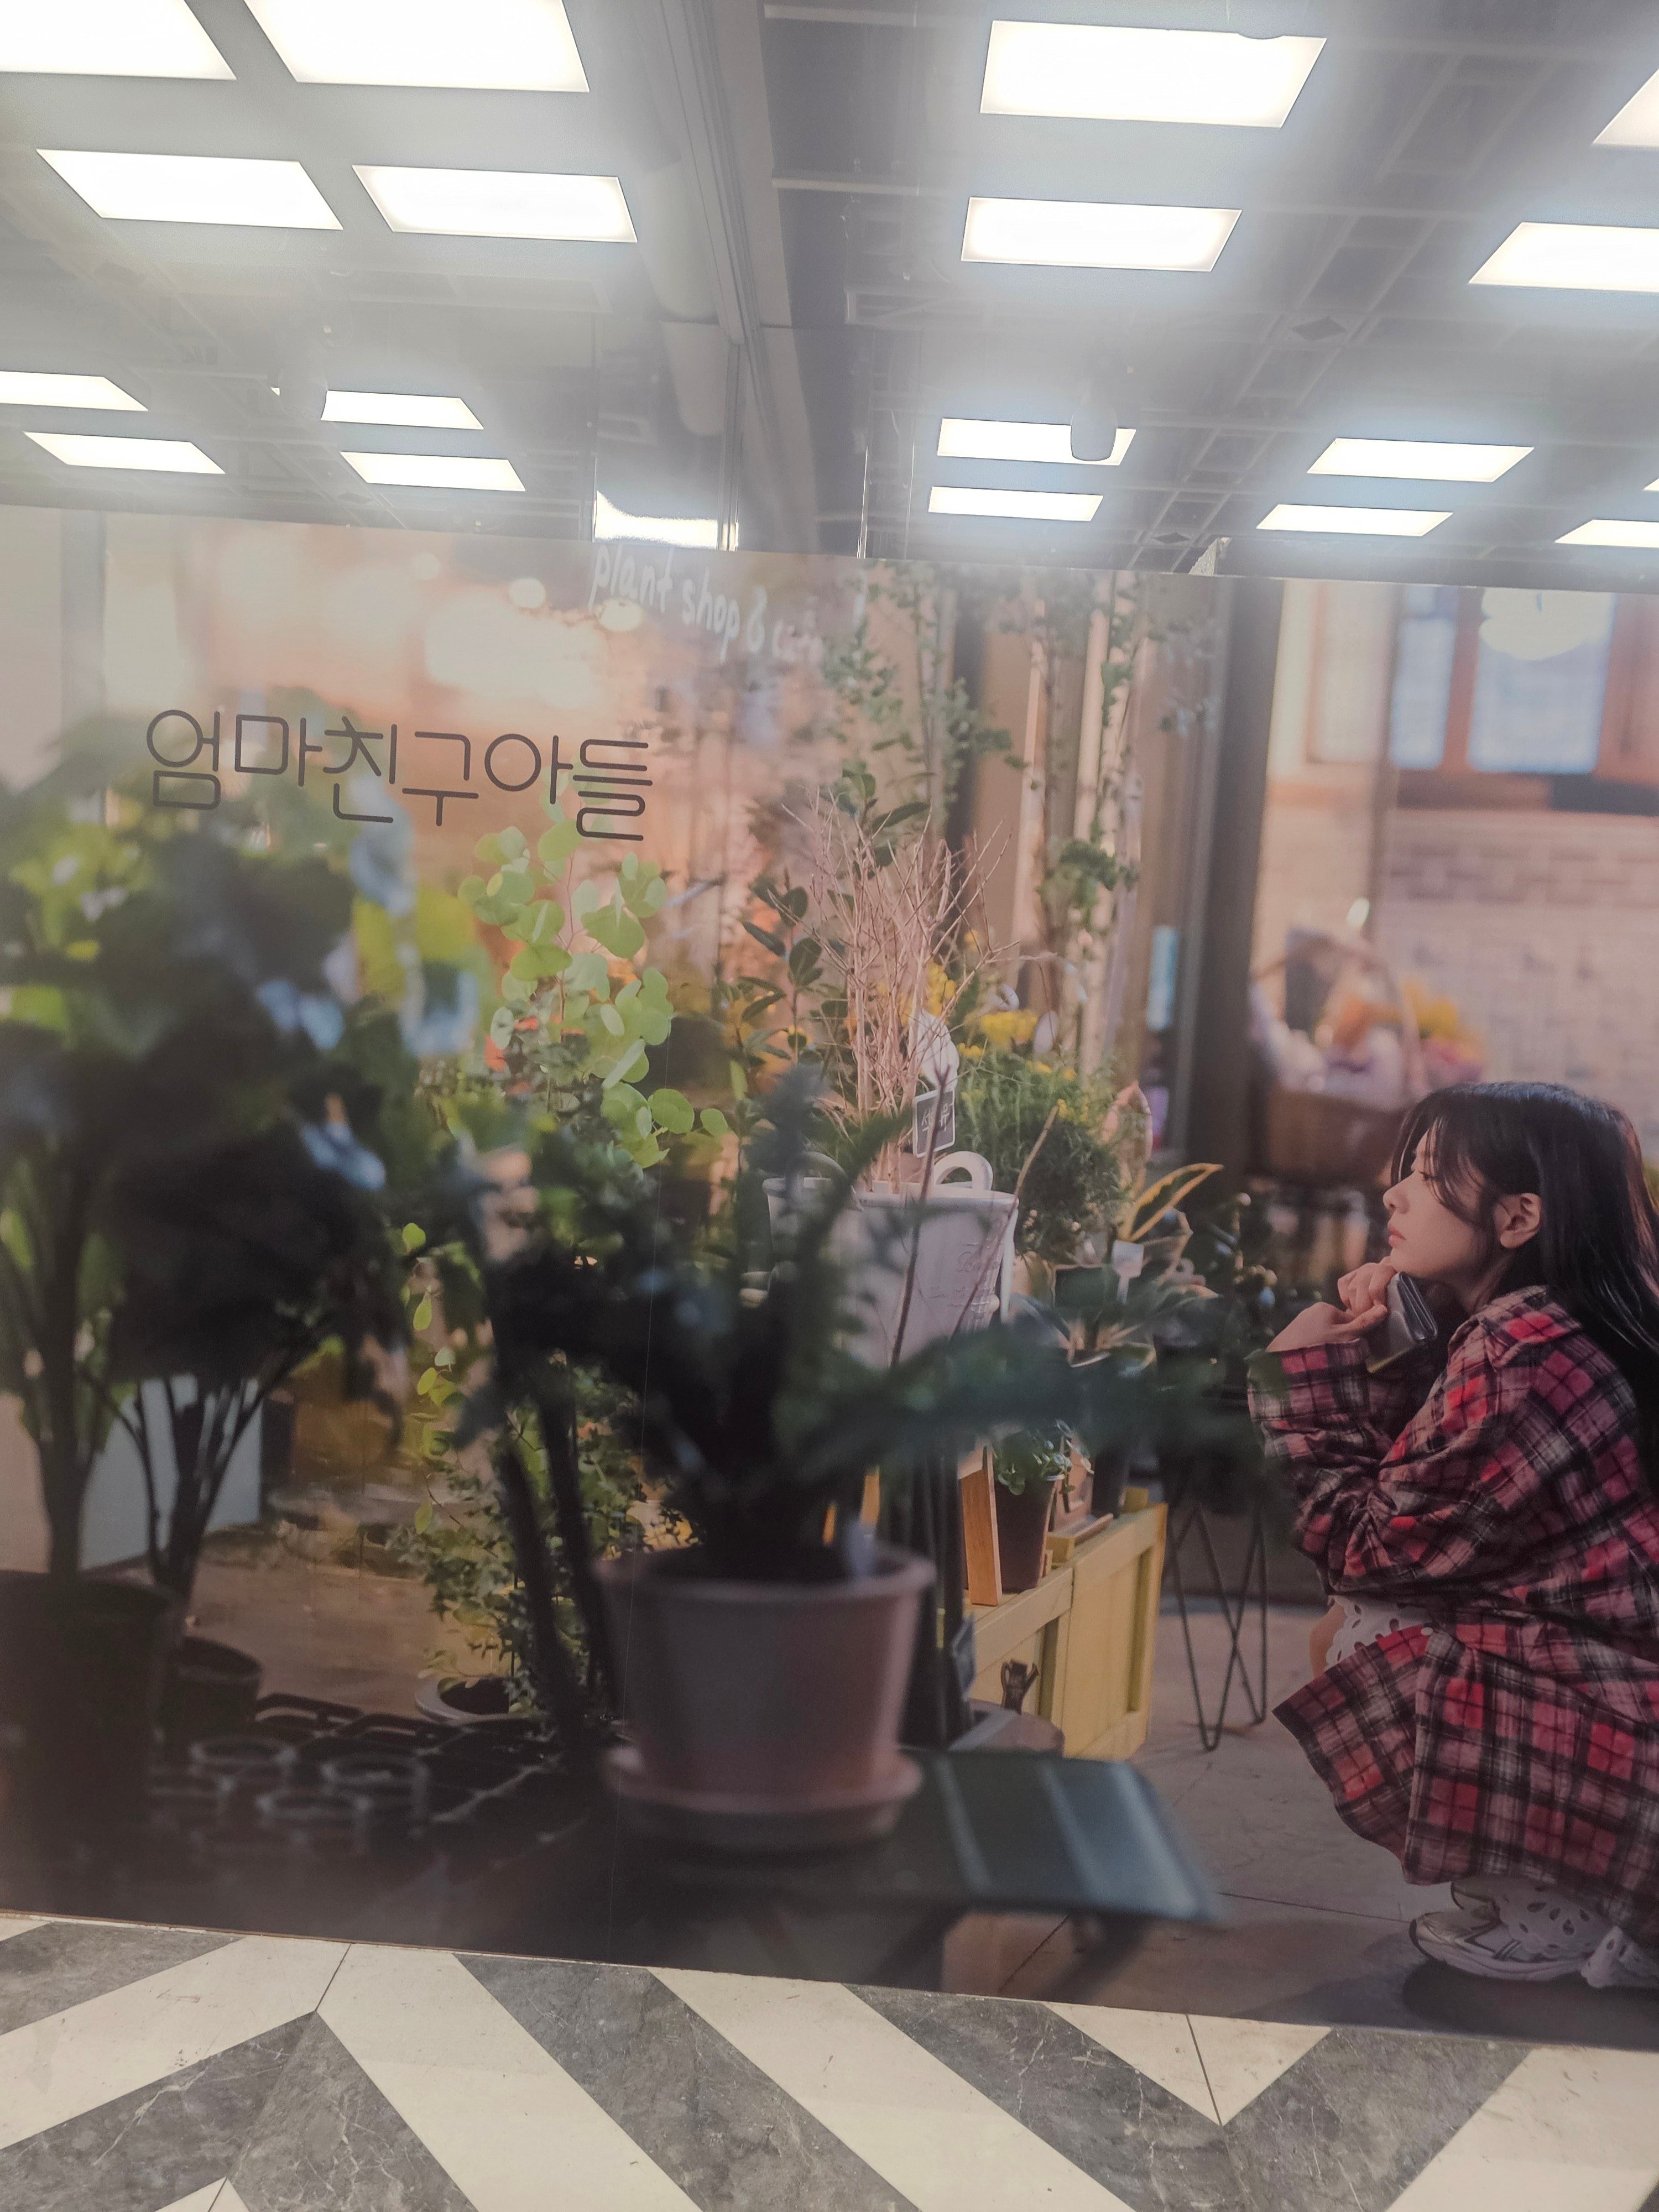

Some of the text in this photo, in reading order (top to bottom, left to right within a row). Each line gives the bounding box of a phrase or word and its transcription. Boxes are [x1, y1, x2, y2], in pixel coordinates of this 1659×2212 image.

[588, 545, 674, 614] plant
[681, 566, 741, 664] shop
[147, 709, 653, 842] 엄마친구아들
